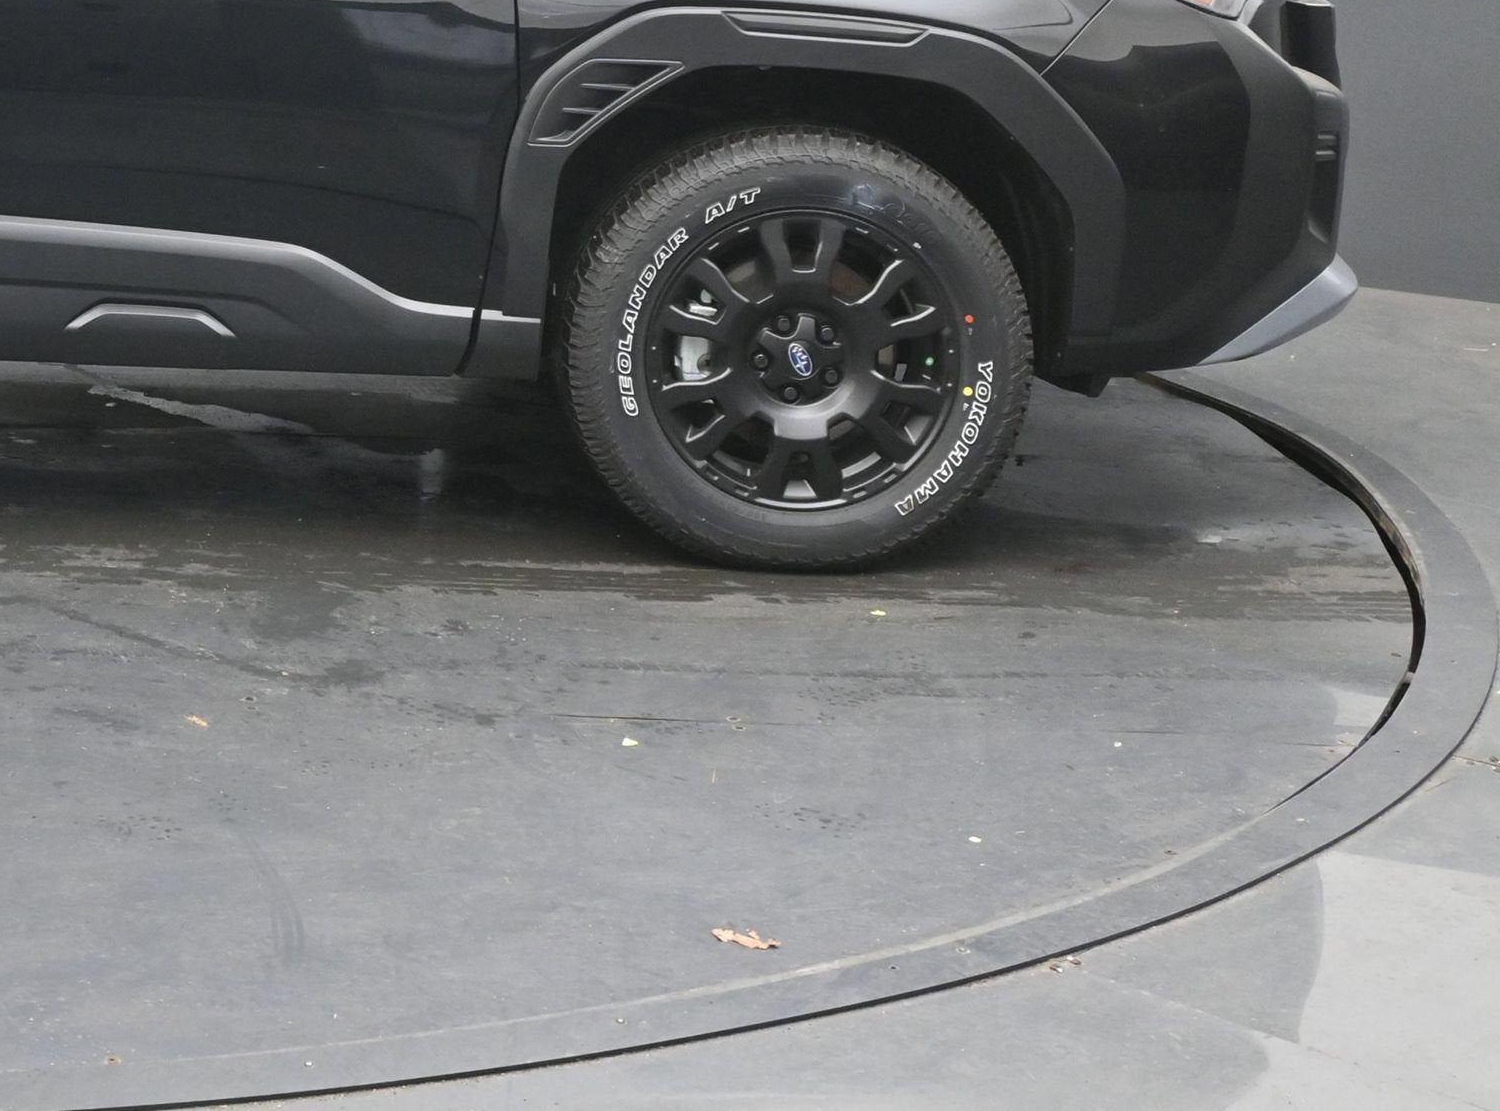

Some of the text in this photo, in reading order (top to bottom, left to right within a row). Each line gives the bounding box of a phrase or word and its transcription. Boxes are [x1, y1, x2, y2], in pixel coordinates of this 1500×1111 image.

[617, 187, 760, 416] GEOLANDAR A/T
[894, 361, 993, 516] YOKOHAMA
